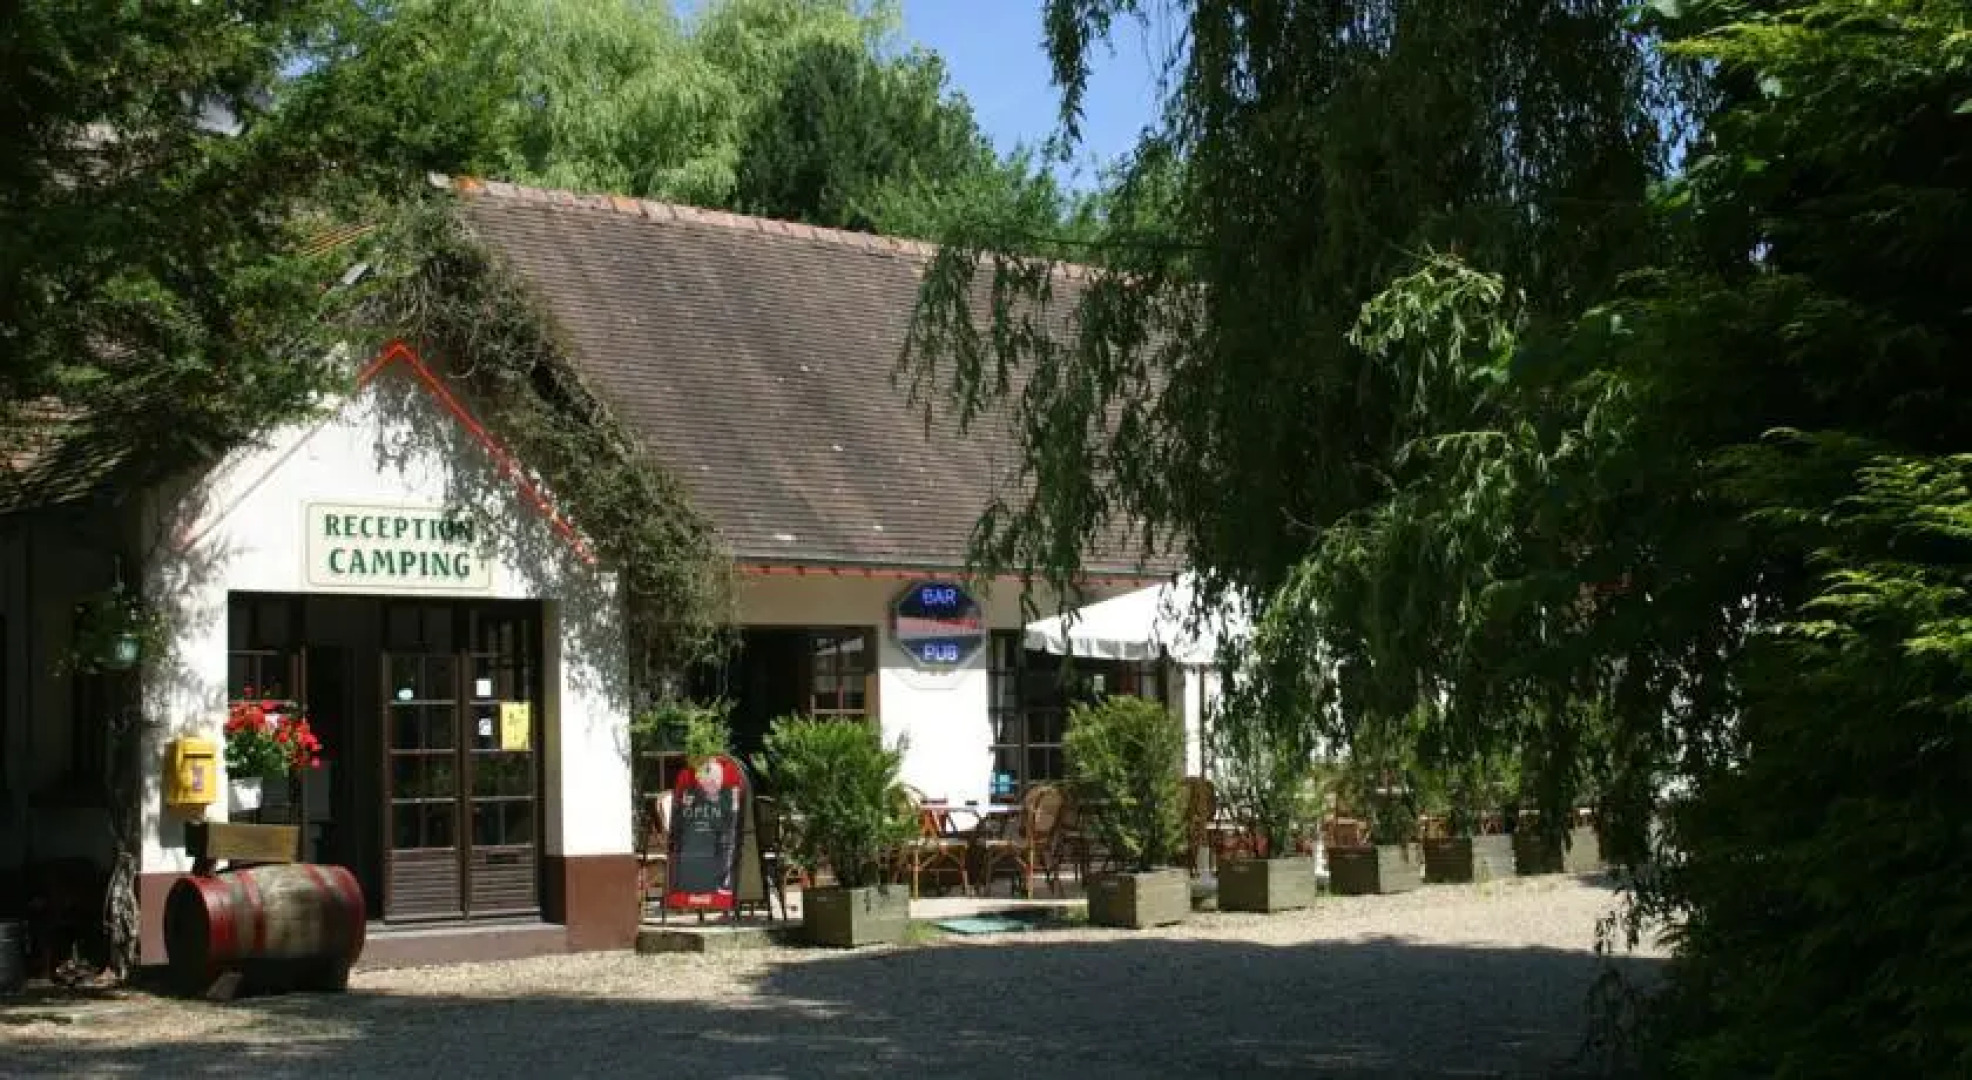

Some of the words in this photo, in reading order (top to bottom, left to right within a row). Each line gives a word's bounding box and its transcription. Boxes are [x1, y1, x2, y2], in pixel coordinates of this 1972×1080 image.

[324, 513, 474, 543] RECEPTION
[328, 547, 470, 578] CAMPING
[922, 587, 957, 606] BAR
[924, 643, 959, 661] PUB
